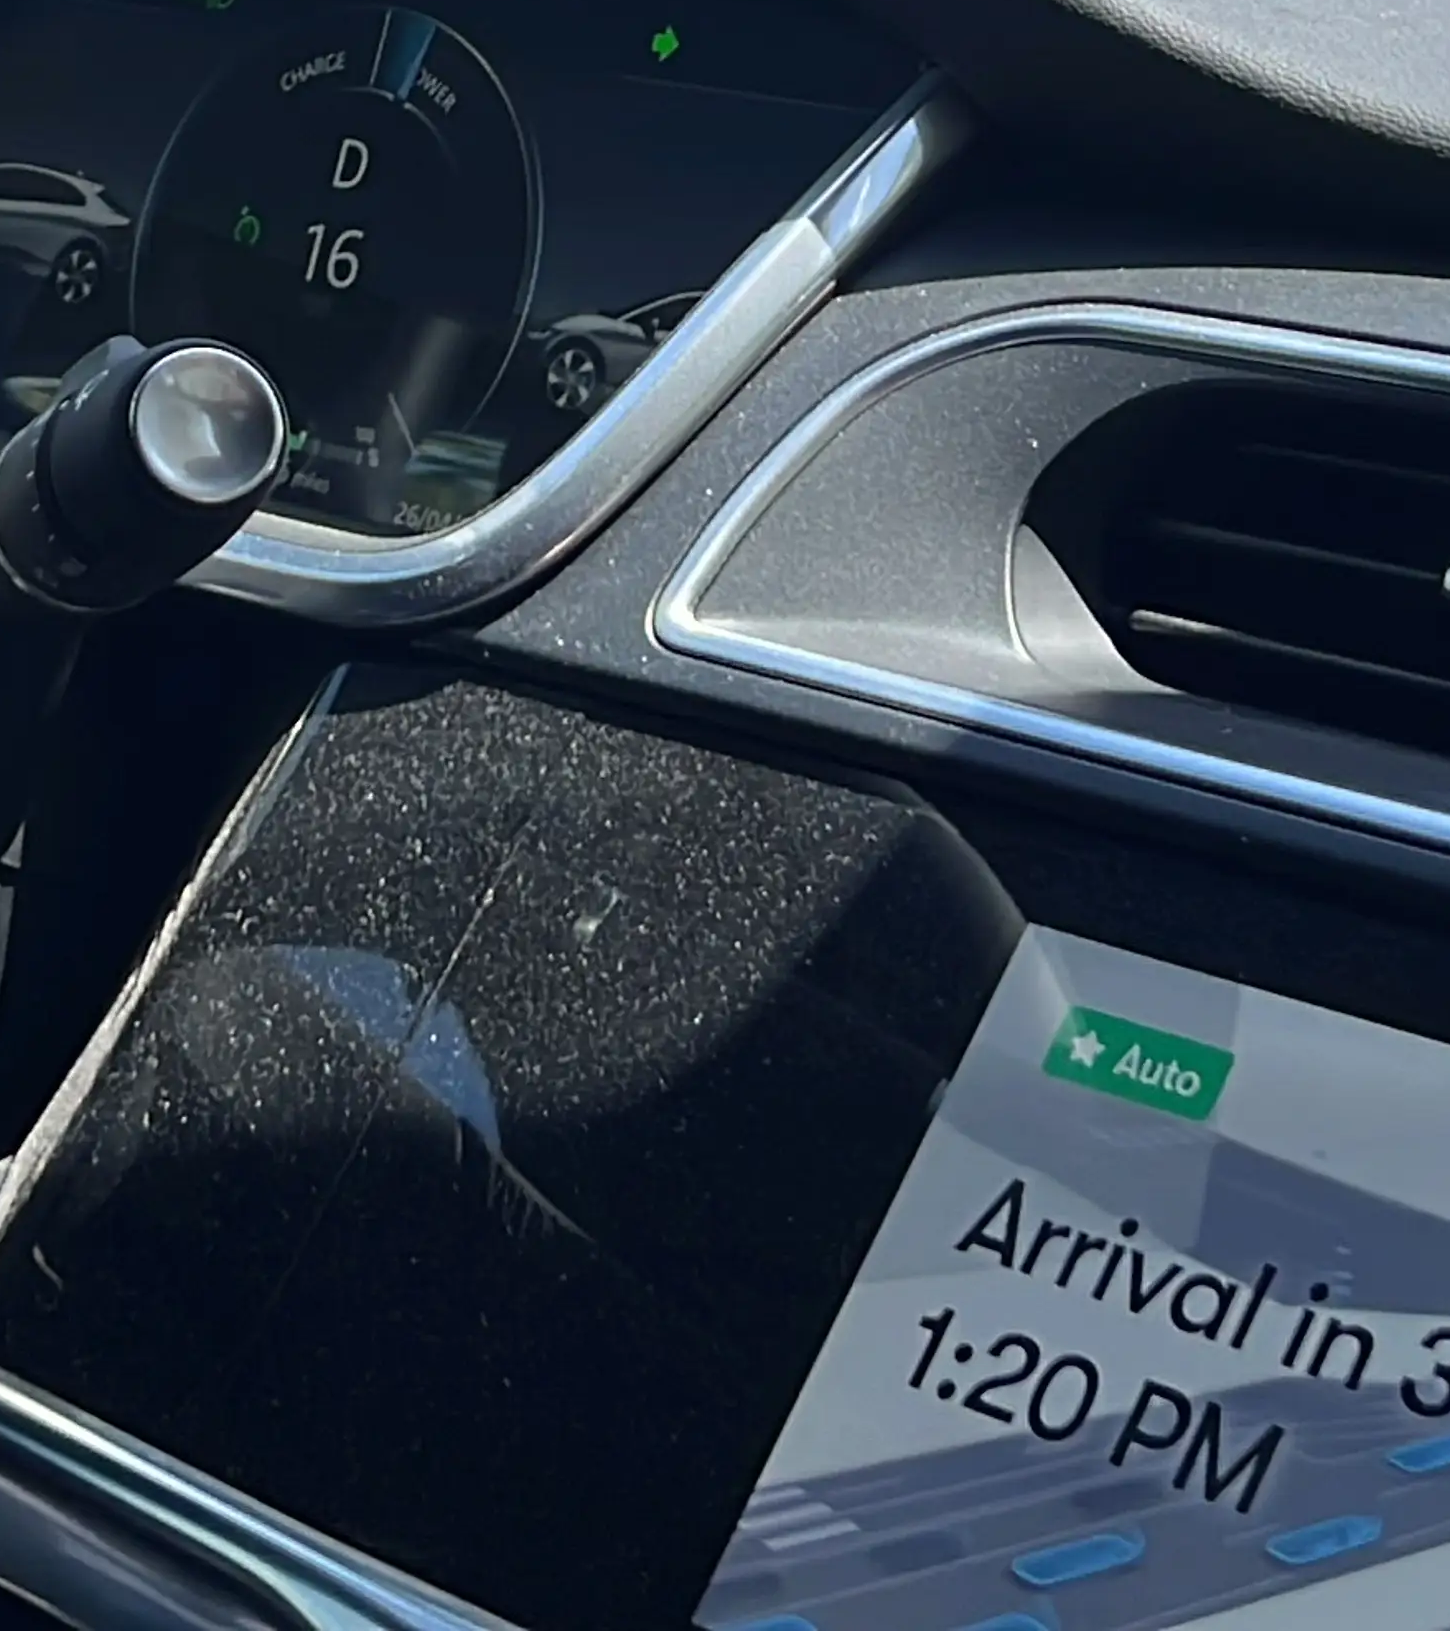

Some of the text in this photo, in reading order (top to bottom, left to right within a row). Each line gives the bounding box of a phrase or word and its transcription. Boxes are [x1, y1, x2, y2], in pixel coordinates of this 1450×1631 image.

[278, 50, 347, 93] CHARGE
[331, 137, 371, 190] D
[304, 223, 366, 290] 16
[1112, 1042, 1202, 1098] Auto
[953, 1177, 1279, 1350] Arrival
[1281, 1281, 1376, 1391] in
[907, 1305, 1285, 1515] 1:20 PM
